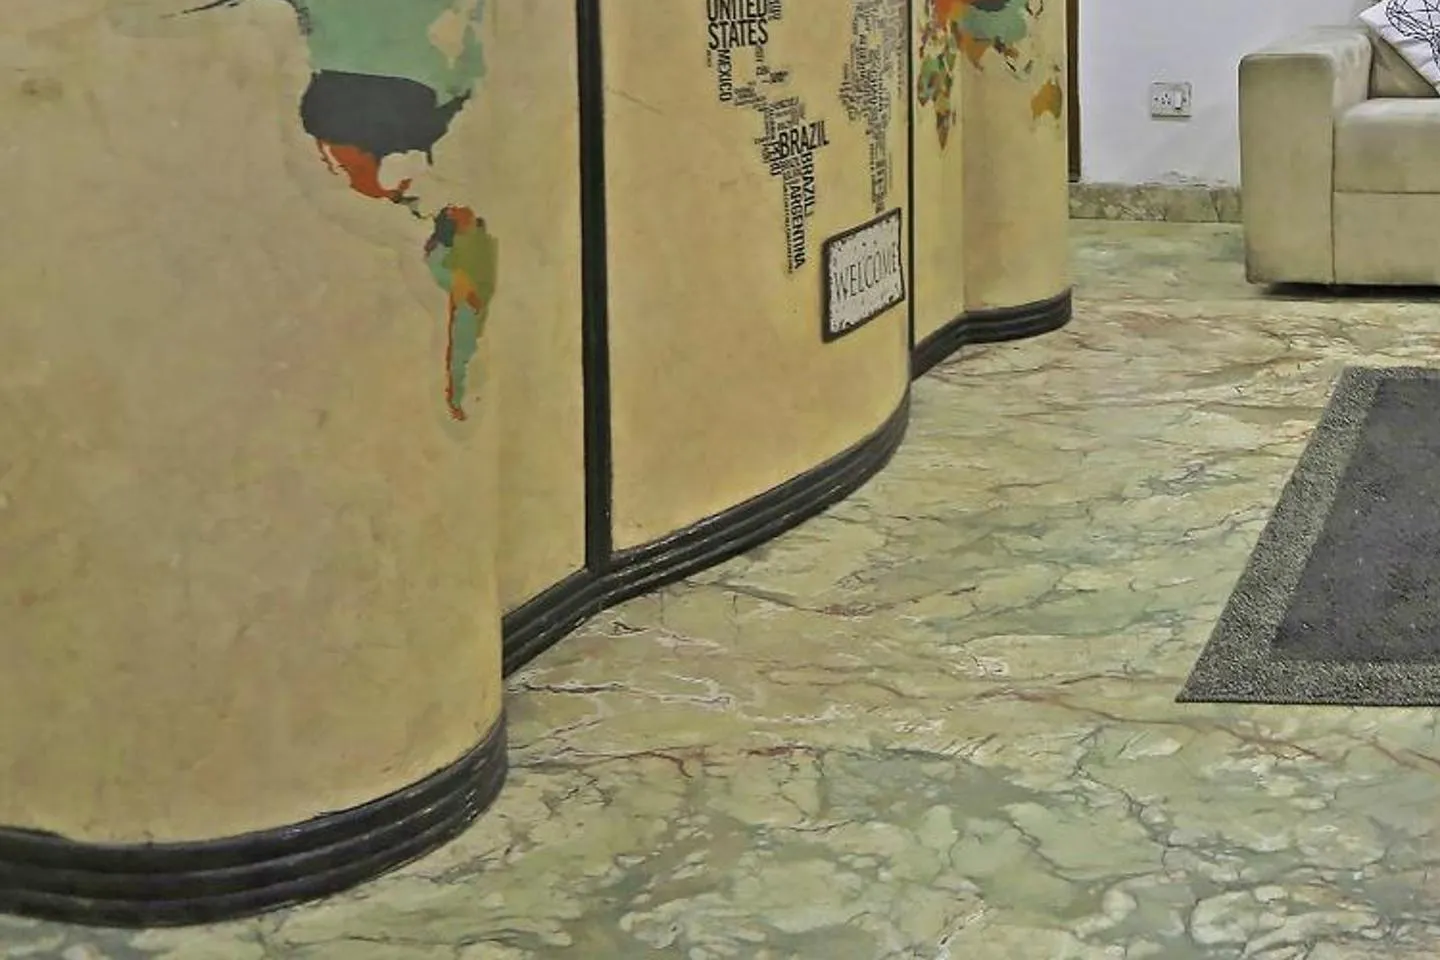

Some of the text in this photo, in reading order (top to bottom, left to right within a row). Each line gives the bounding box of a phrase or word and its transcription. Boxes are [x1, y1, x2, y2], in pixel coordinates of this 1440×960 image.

[708, 19, 769, 51] STATES
[717, 48, 733, 102] MEXICO
[778, 120, 830, 159] BRAZIL
[801, 151, 816, 217] BRAZIL
[832, 246, 898, 303] WELCOME
